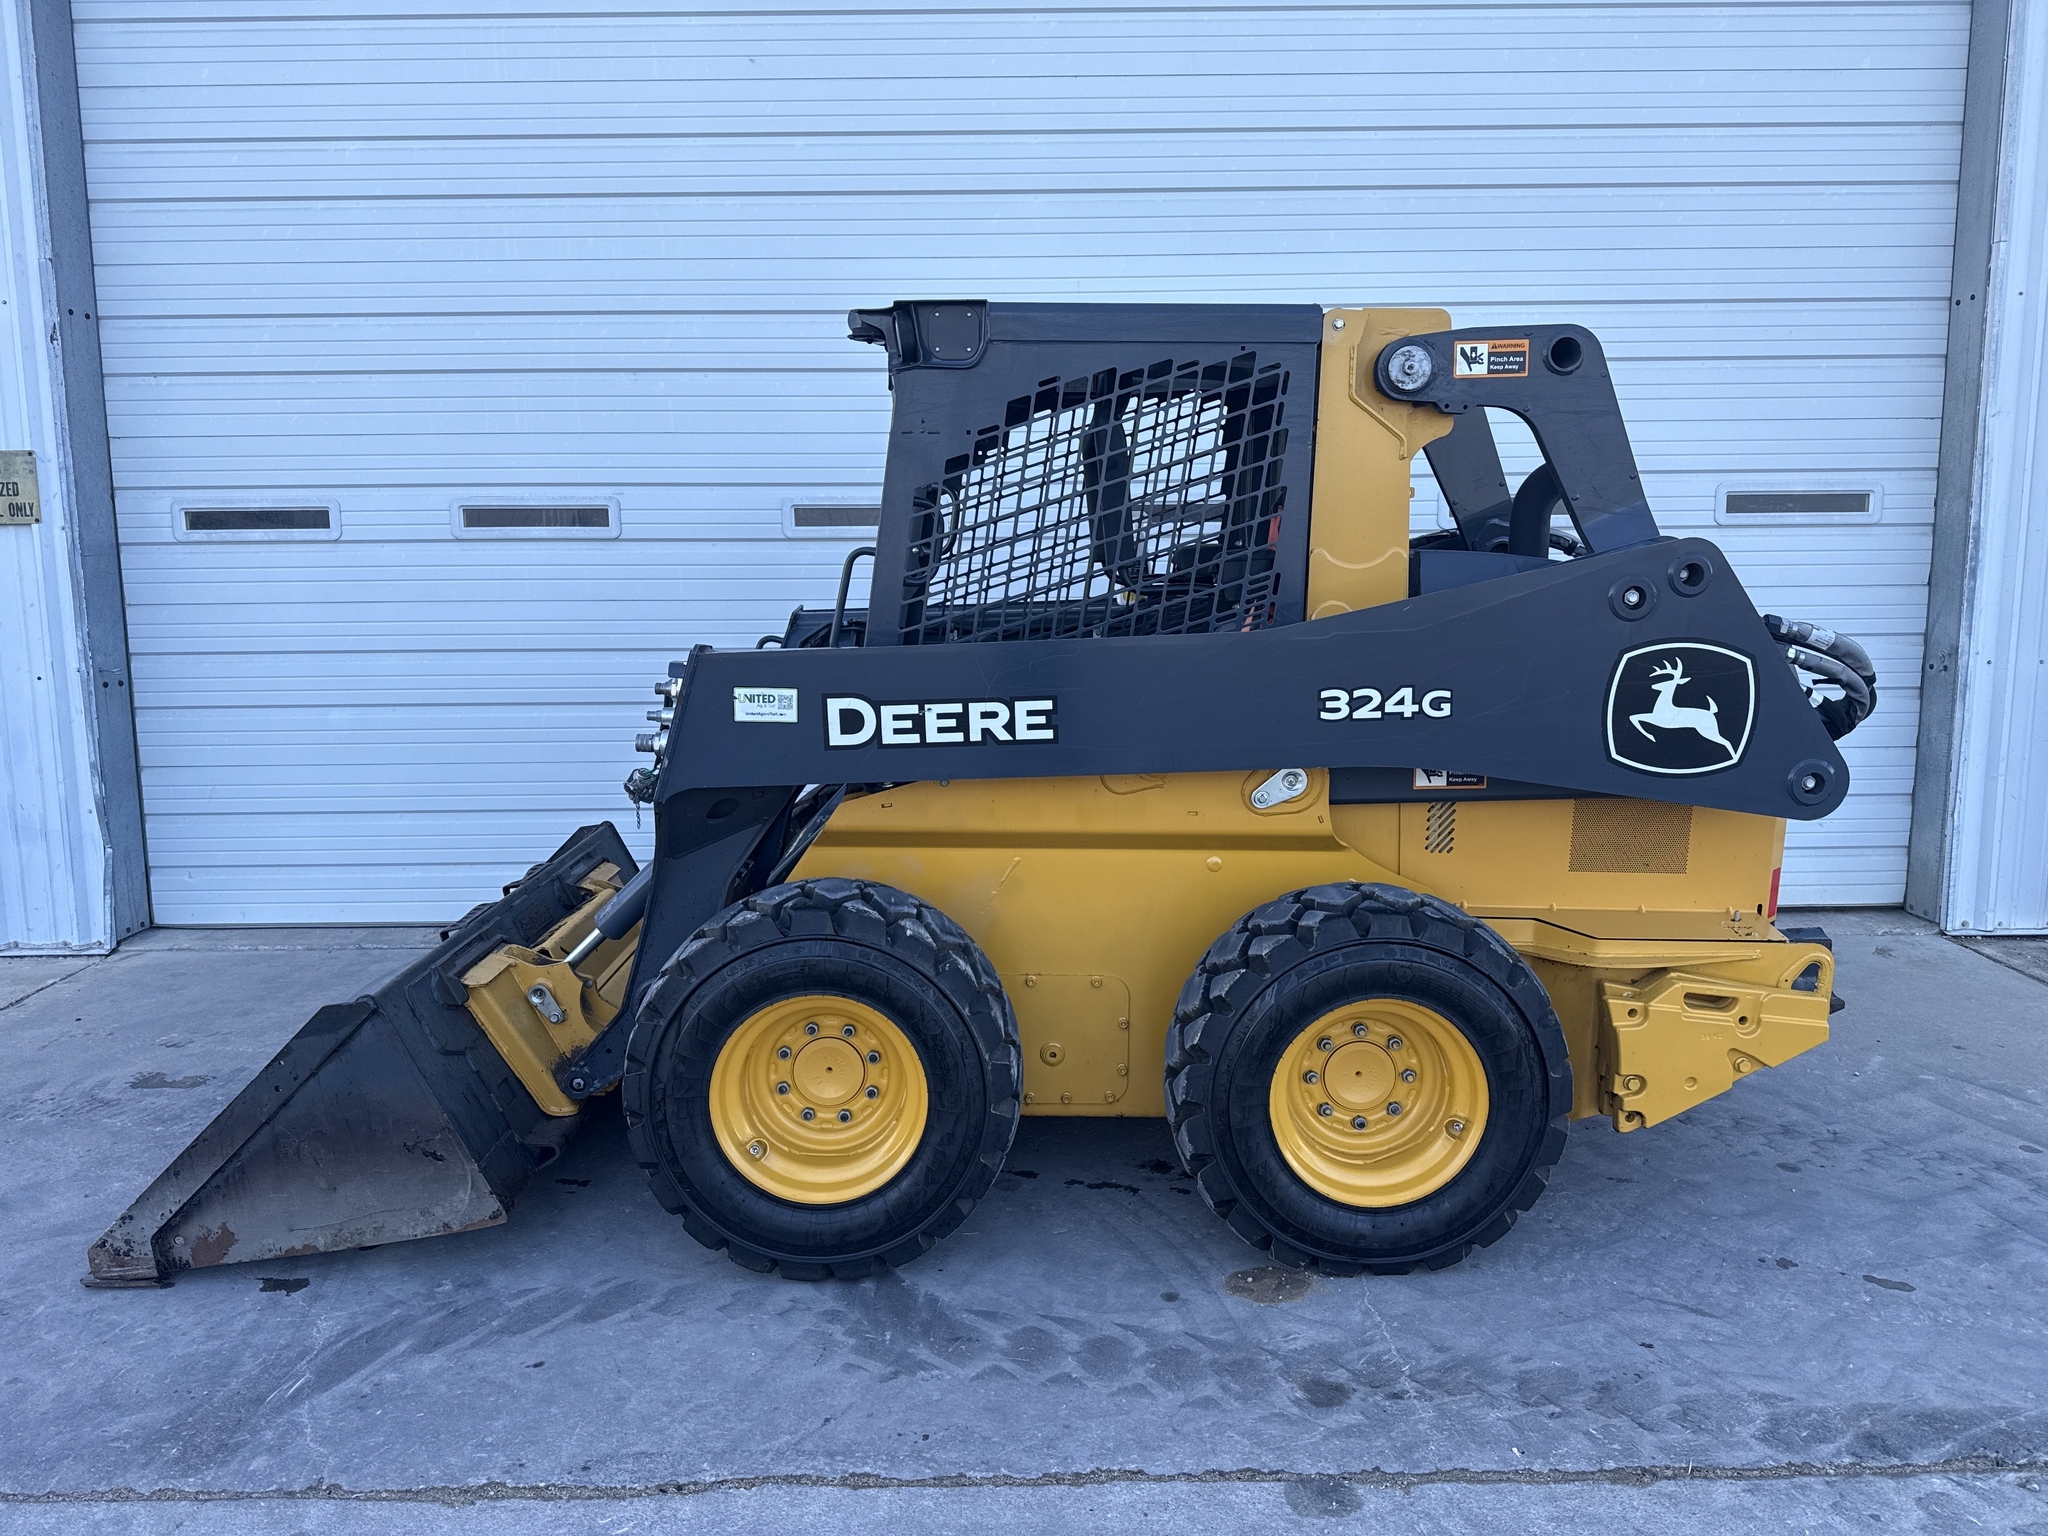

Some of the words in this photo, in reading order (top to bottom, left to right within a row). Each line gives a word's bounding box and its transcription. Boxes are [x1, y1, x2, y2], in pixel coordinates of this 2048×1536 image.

[8, 502, 34, 517] ONLY
[738, 693, 776, 704] UNITED
[1320, 687, 1452, 720] 324G
[827, 697, 1054, 746] DEERE
